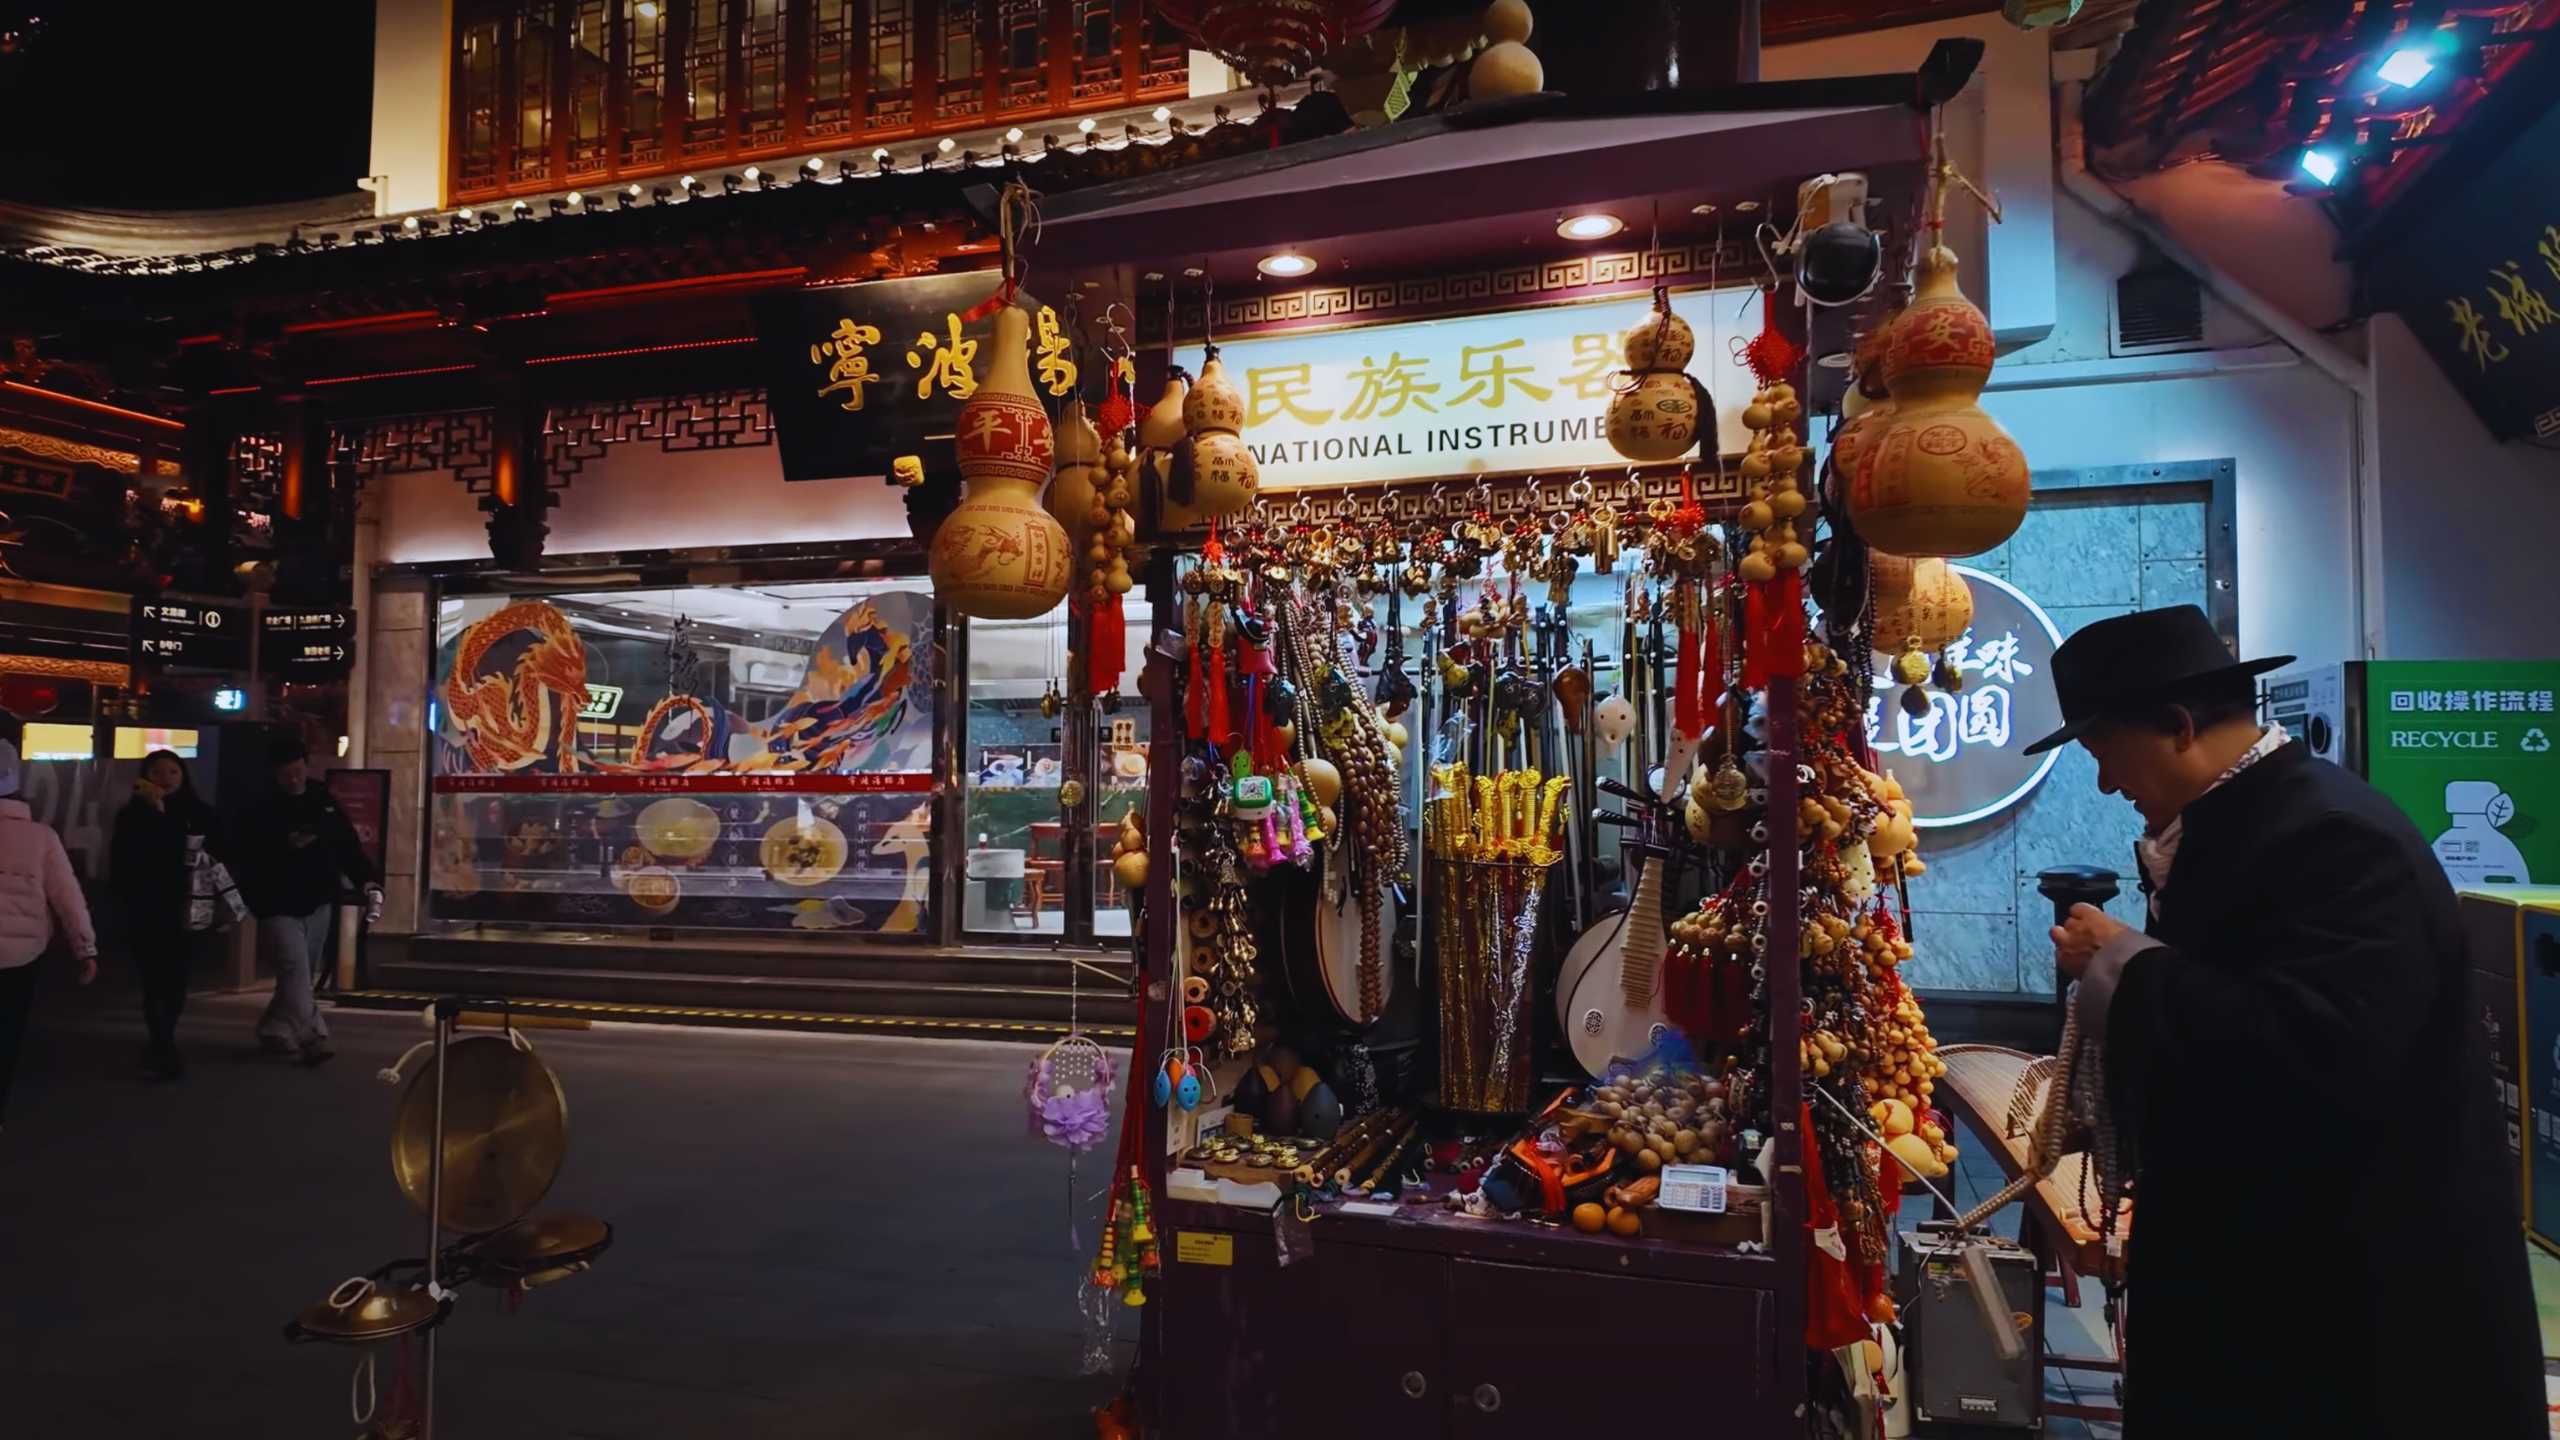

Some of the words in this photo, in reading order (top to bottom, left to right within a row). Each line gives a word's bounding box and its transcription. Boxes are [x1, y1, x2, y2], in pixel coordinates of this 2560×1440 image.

[1244, 333, 1629, 430] 民族乐器
[1249, 432, 1412, 465] NATIONAL
[1427, 418, 1607, 454] INSTRUME
[2391, 690, 2554, 711] 回收操作流程
[2391, 731, 2499, 748] RECYCLE
